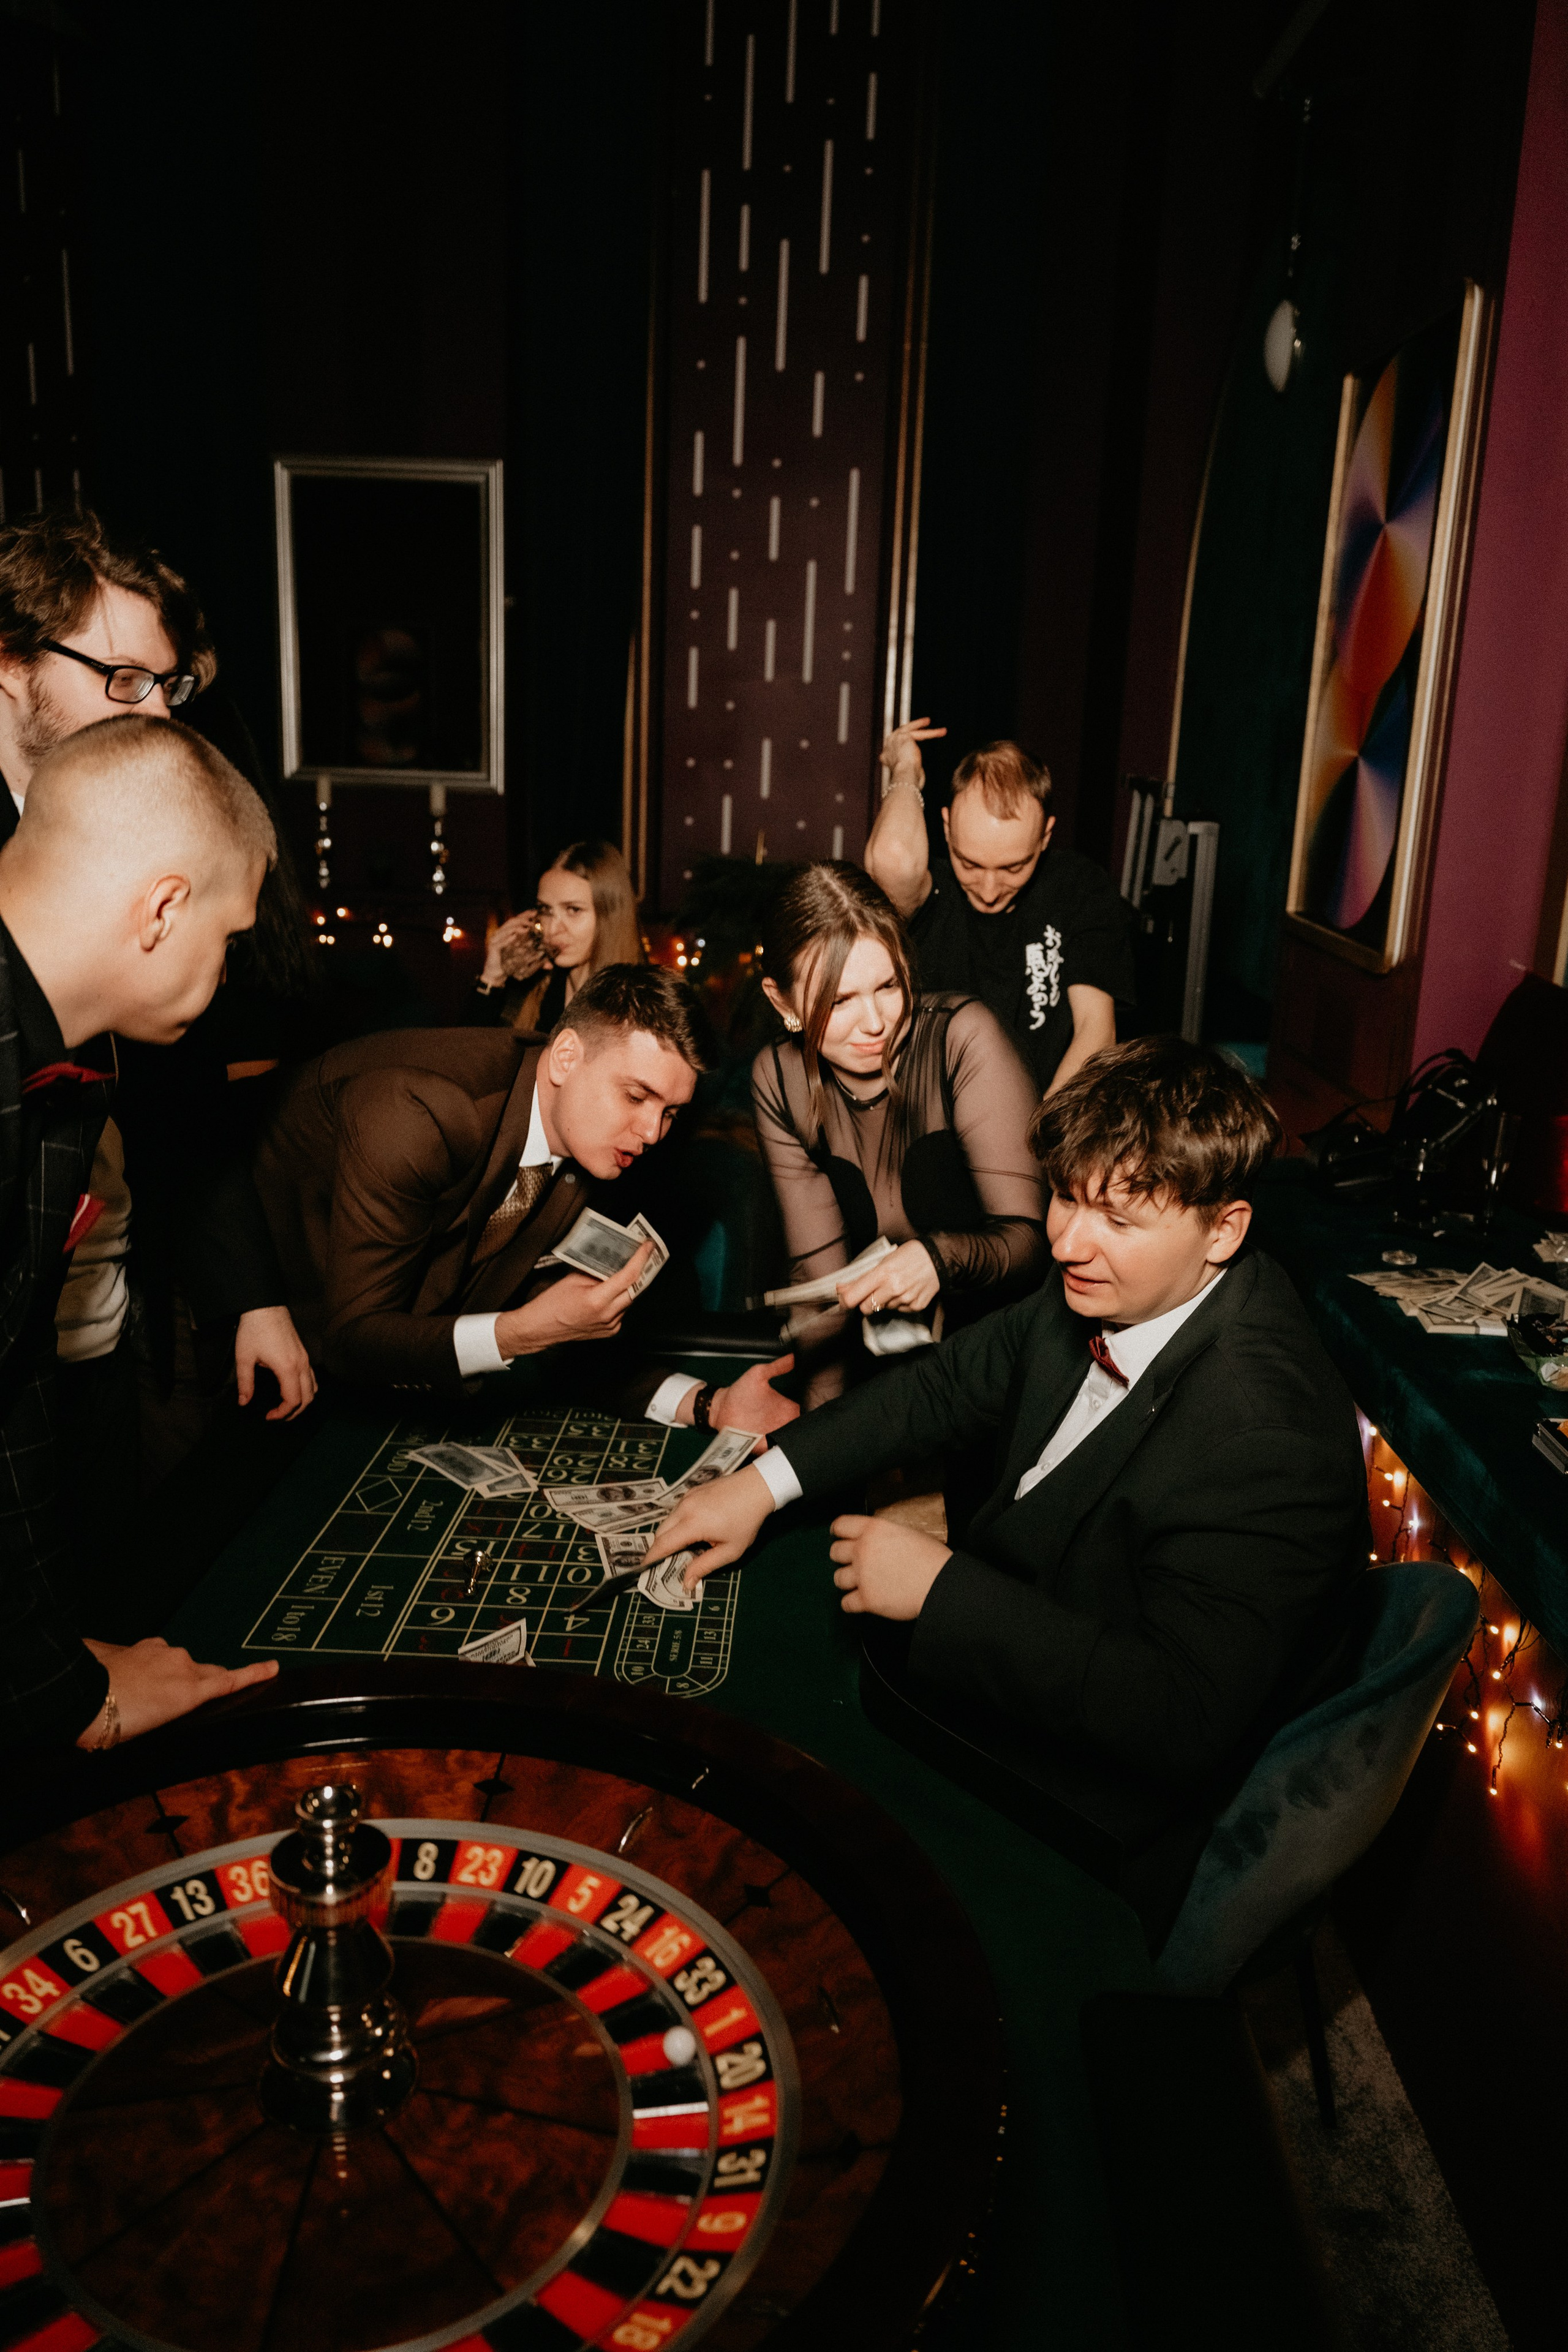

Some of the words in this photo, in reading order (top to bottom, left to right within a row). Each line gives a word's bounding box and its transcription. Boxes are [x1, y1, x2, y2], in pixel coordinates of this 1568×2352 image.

[508, 1436, 551, 1449] 33
[568, 1423, 611, 1437] 35
[552, 1453, 600, 1468] 29
[618, 1440, 657, 1454] 31
[546, 1469, 593, 1484] 26
[608, 1455, 653, 1470] 28
[521, 1523, 564, 1539] 17
[577, 1545, 598, 1562] 3
[304, 1556, 347, 1594] EVEN
[510, 1564, 549, 1583] 11
[566, 1566, 592, 1584] 0
[506, 1586, 531, 1605] 8
[428, 1606, 456, 1626] 6
[564, 1615, 590, 1632] 4
[562, 1638, 572, 1657] 1
[704, 1630, 717, 1640] 13
[631, 1665, 645, 1676] 10
[699, 1656, 714, 1665] 11
[413, 1842, 439, 1880] 8
[456, 1846, 503, 1887] 23
[227, 1860, 270, 1902] 36
[514, 1856, 556, 1899] 10
[170, 1879, 216, 1921] 13
[568, 1875, 600, 1914] 5
[110, 1902, 159, 1948] 27
[600, 1894, 655, 1940] 24
[62, 1938, 100, 1972] 6
[643, 1924, 692, 1968] 16
[2, 1969, 61, 2015] 34
[674, 1956, 726, 2006] 33
[703, 2007, 747, 2037] 1
[715, 2040, 766, 2089] 20
[722, 2095, 771, 2136] 14
[714, 2147, 767, 2189] 31
[696, 2210, 747, 2235] 9
[655, 2255, 721, 2301] 22
[612, 2312, 673, 2351] 18
